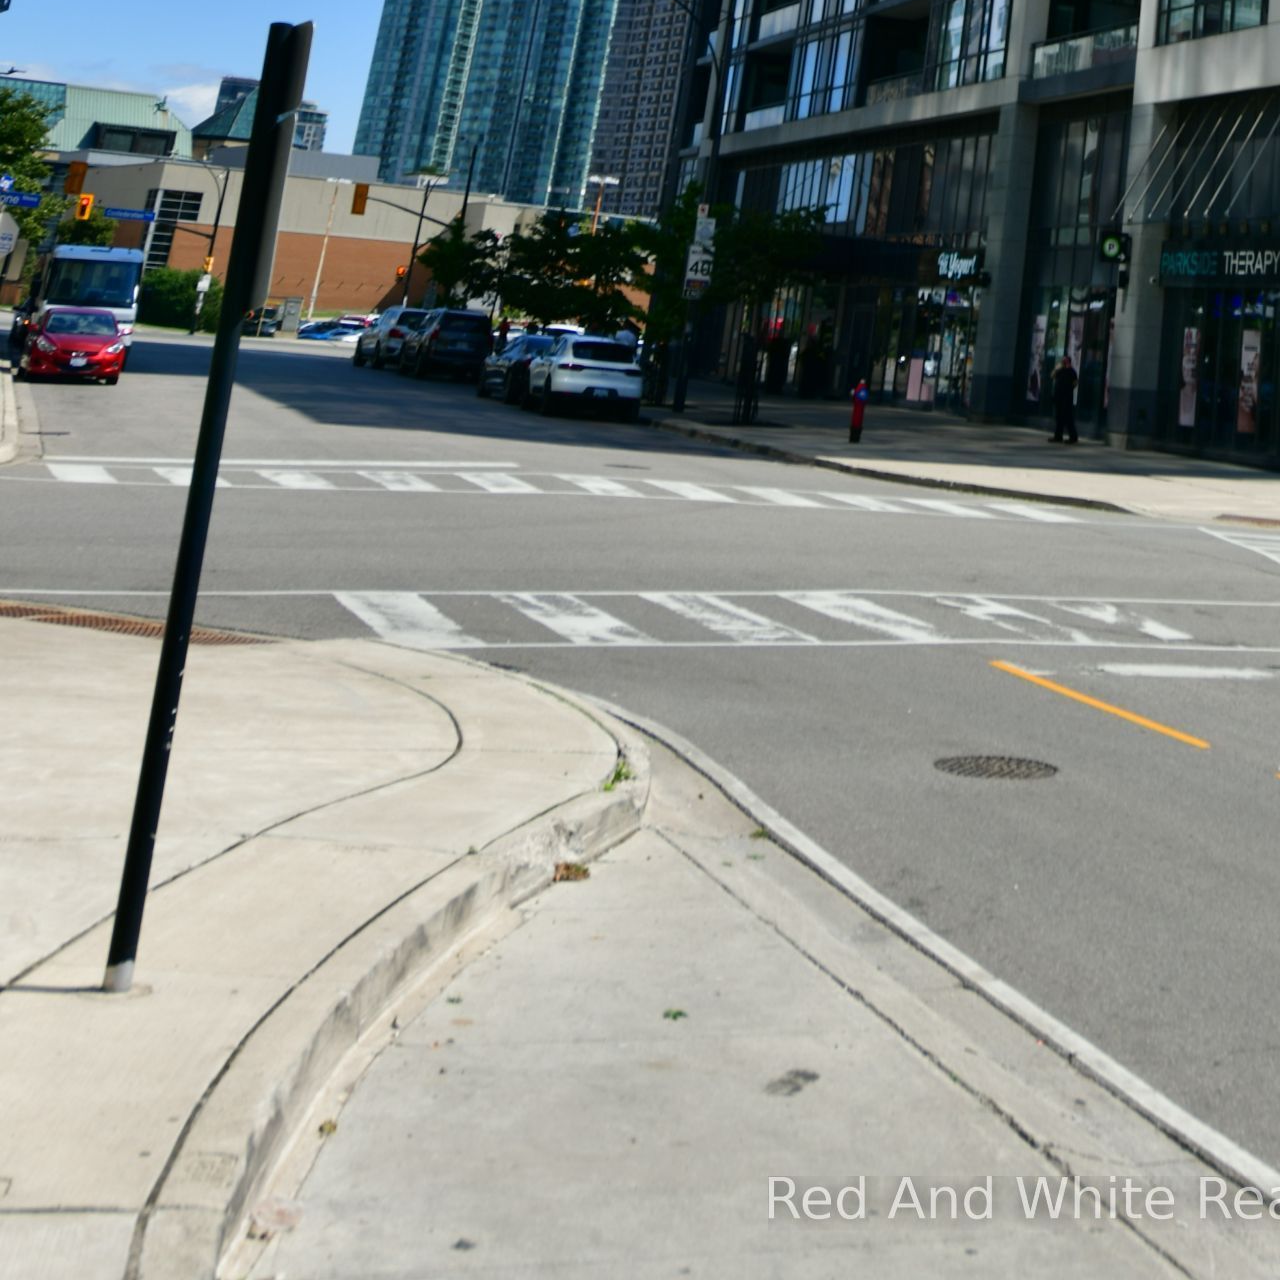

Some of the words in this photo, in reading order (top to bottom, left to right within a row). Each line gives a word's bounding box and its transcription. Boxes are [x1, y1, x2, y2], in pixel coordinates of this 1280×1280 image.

[689, 260, 711, 276] 40
[1161, 251, 1218, 276] PARKSIDE
[1223, 250, 1280, 276] THERAPY
